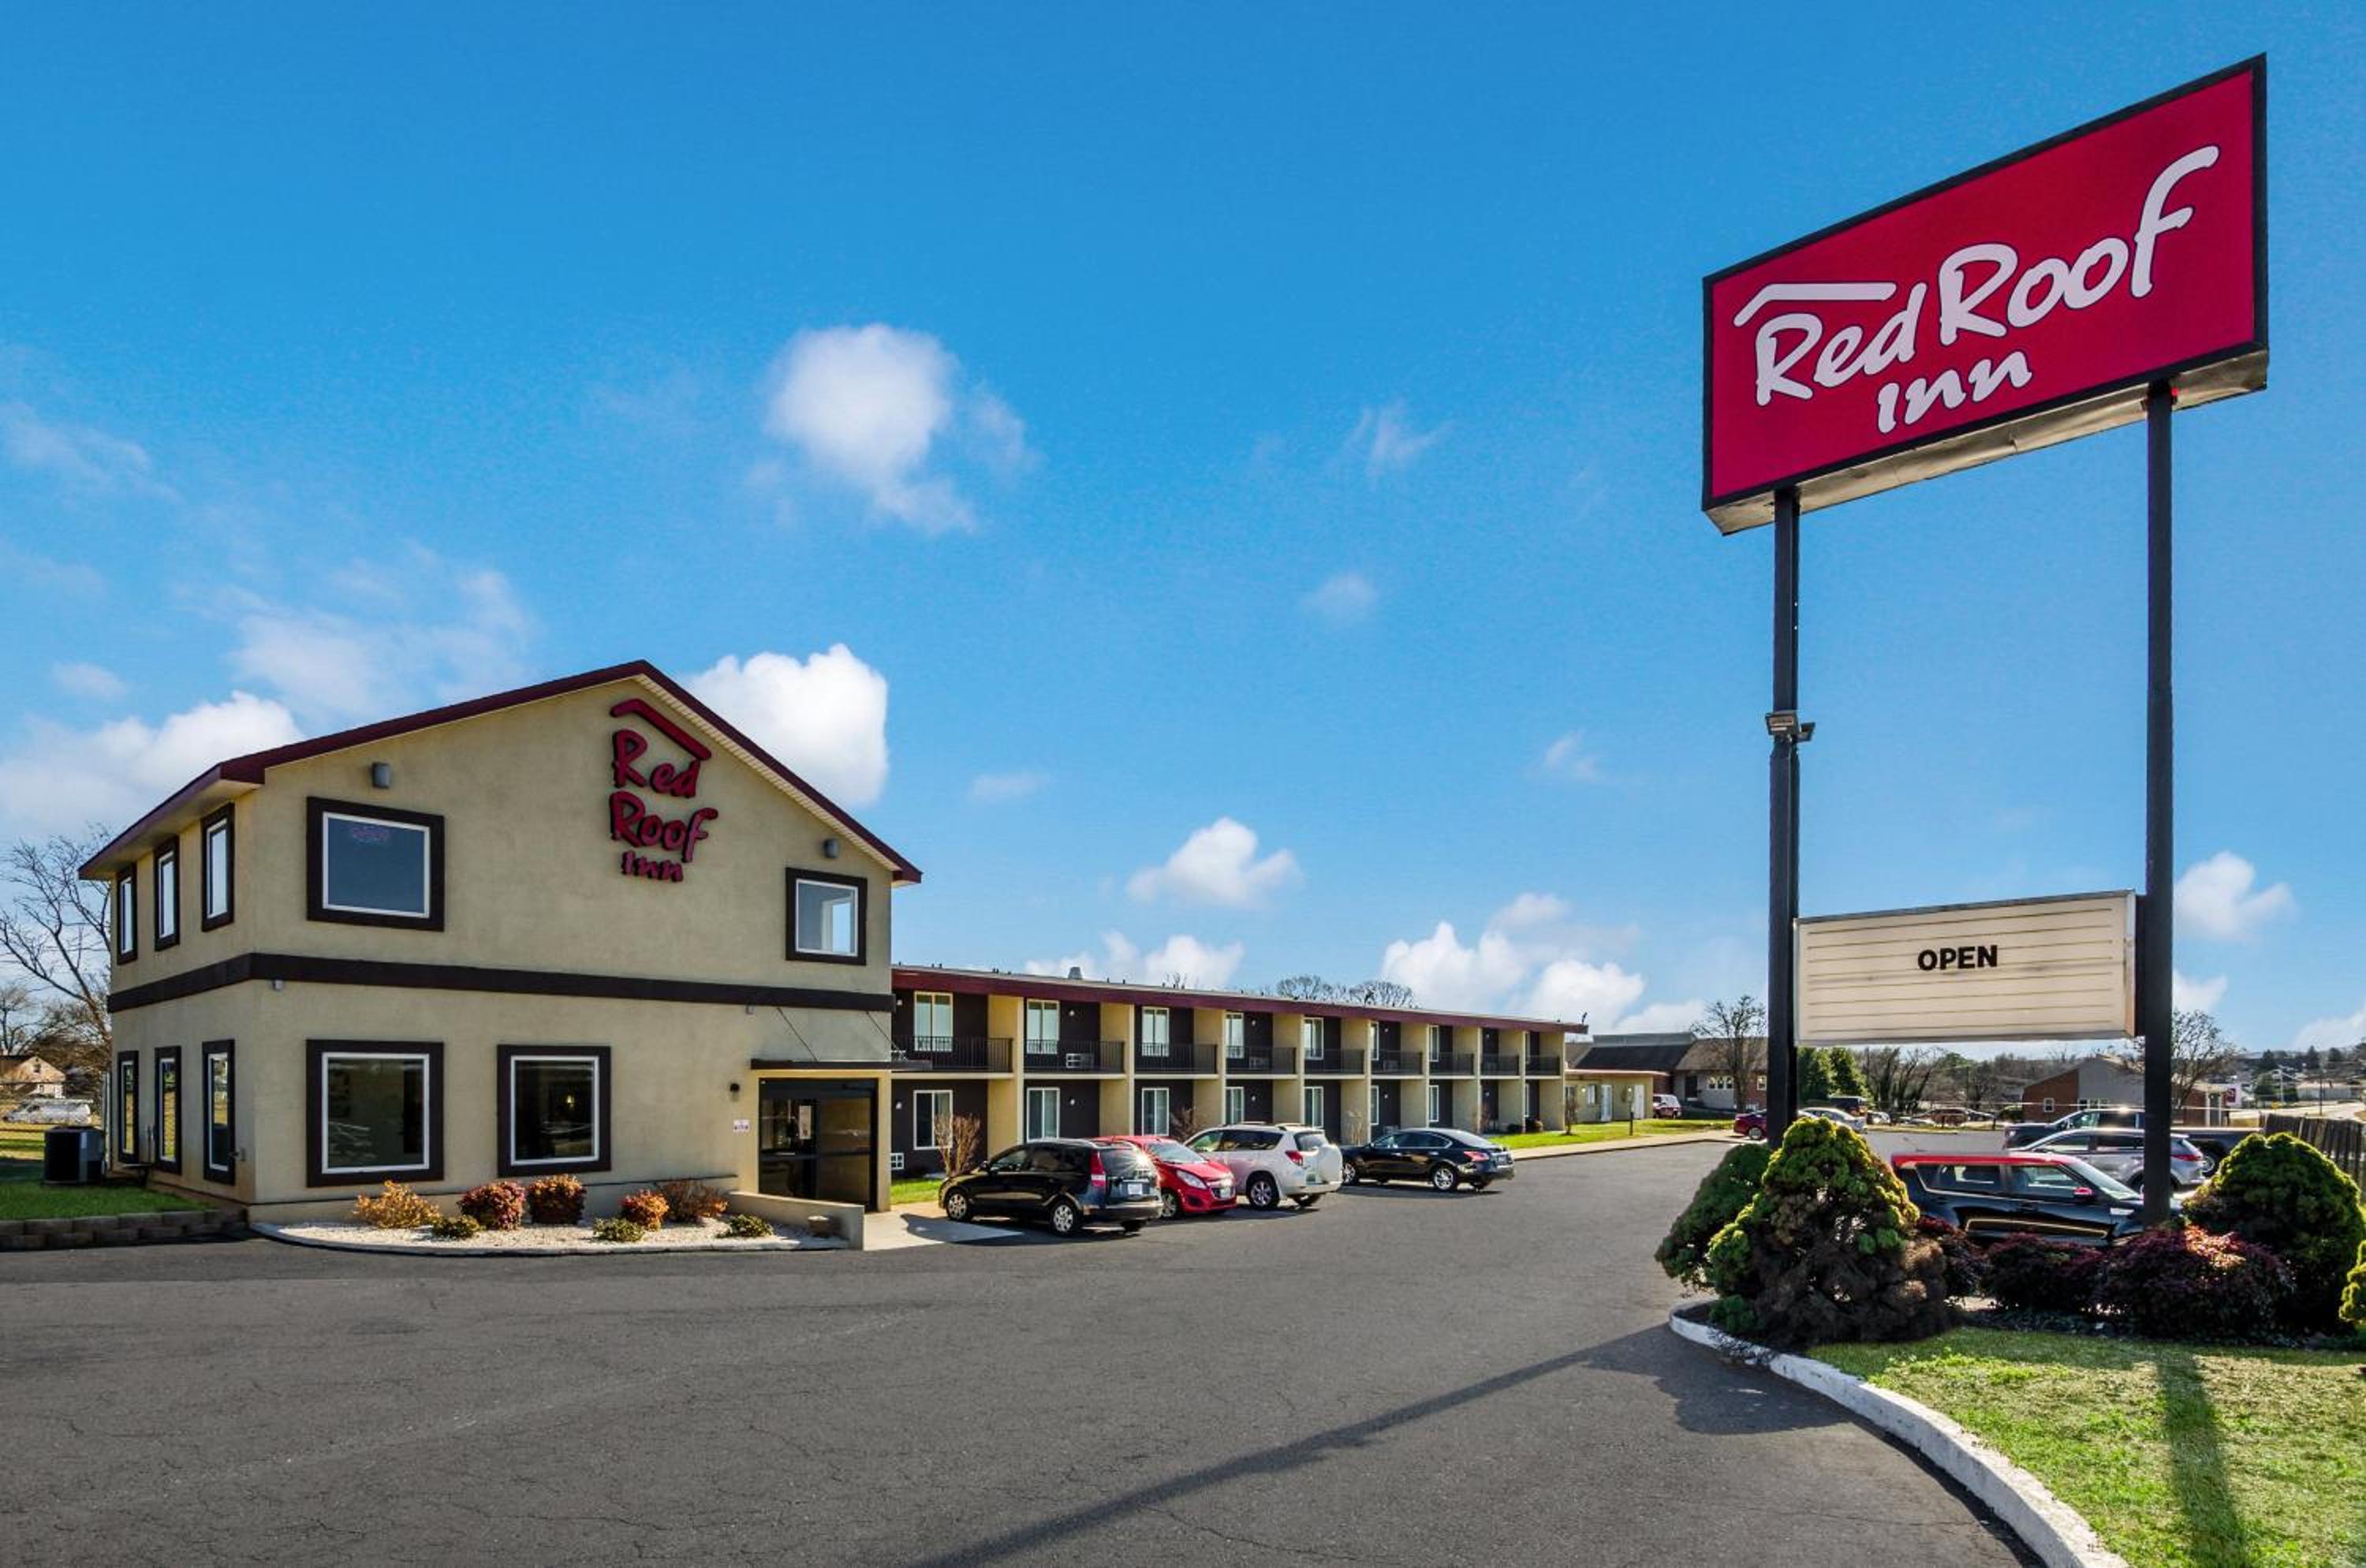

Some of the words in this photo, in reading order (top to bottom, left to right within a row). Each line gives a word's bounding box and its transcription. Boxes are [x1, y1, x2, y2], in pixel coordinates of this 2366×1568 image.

[1755, 282, 1928, 407] Red
[1938, 145, 2220, 345] Roof
[612, 729, 701, 797] Red
[609, 790, 718, 863] Roof
[1917, 944, 1998, 972] OPEN
